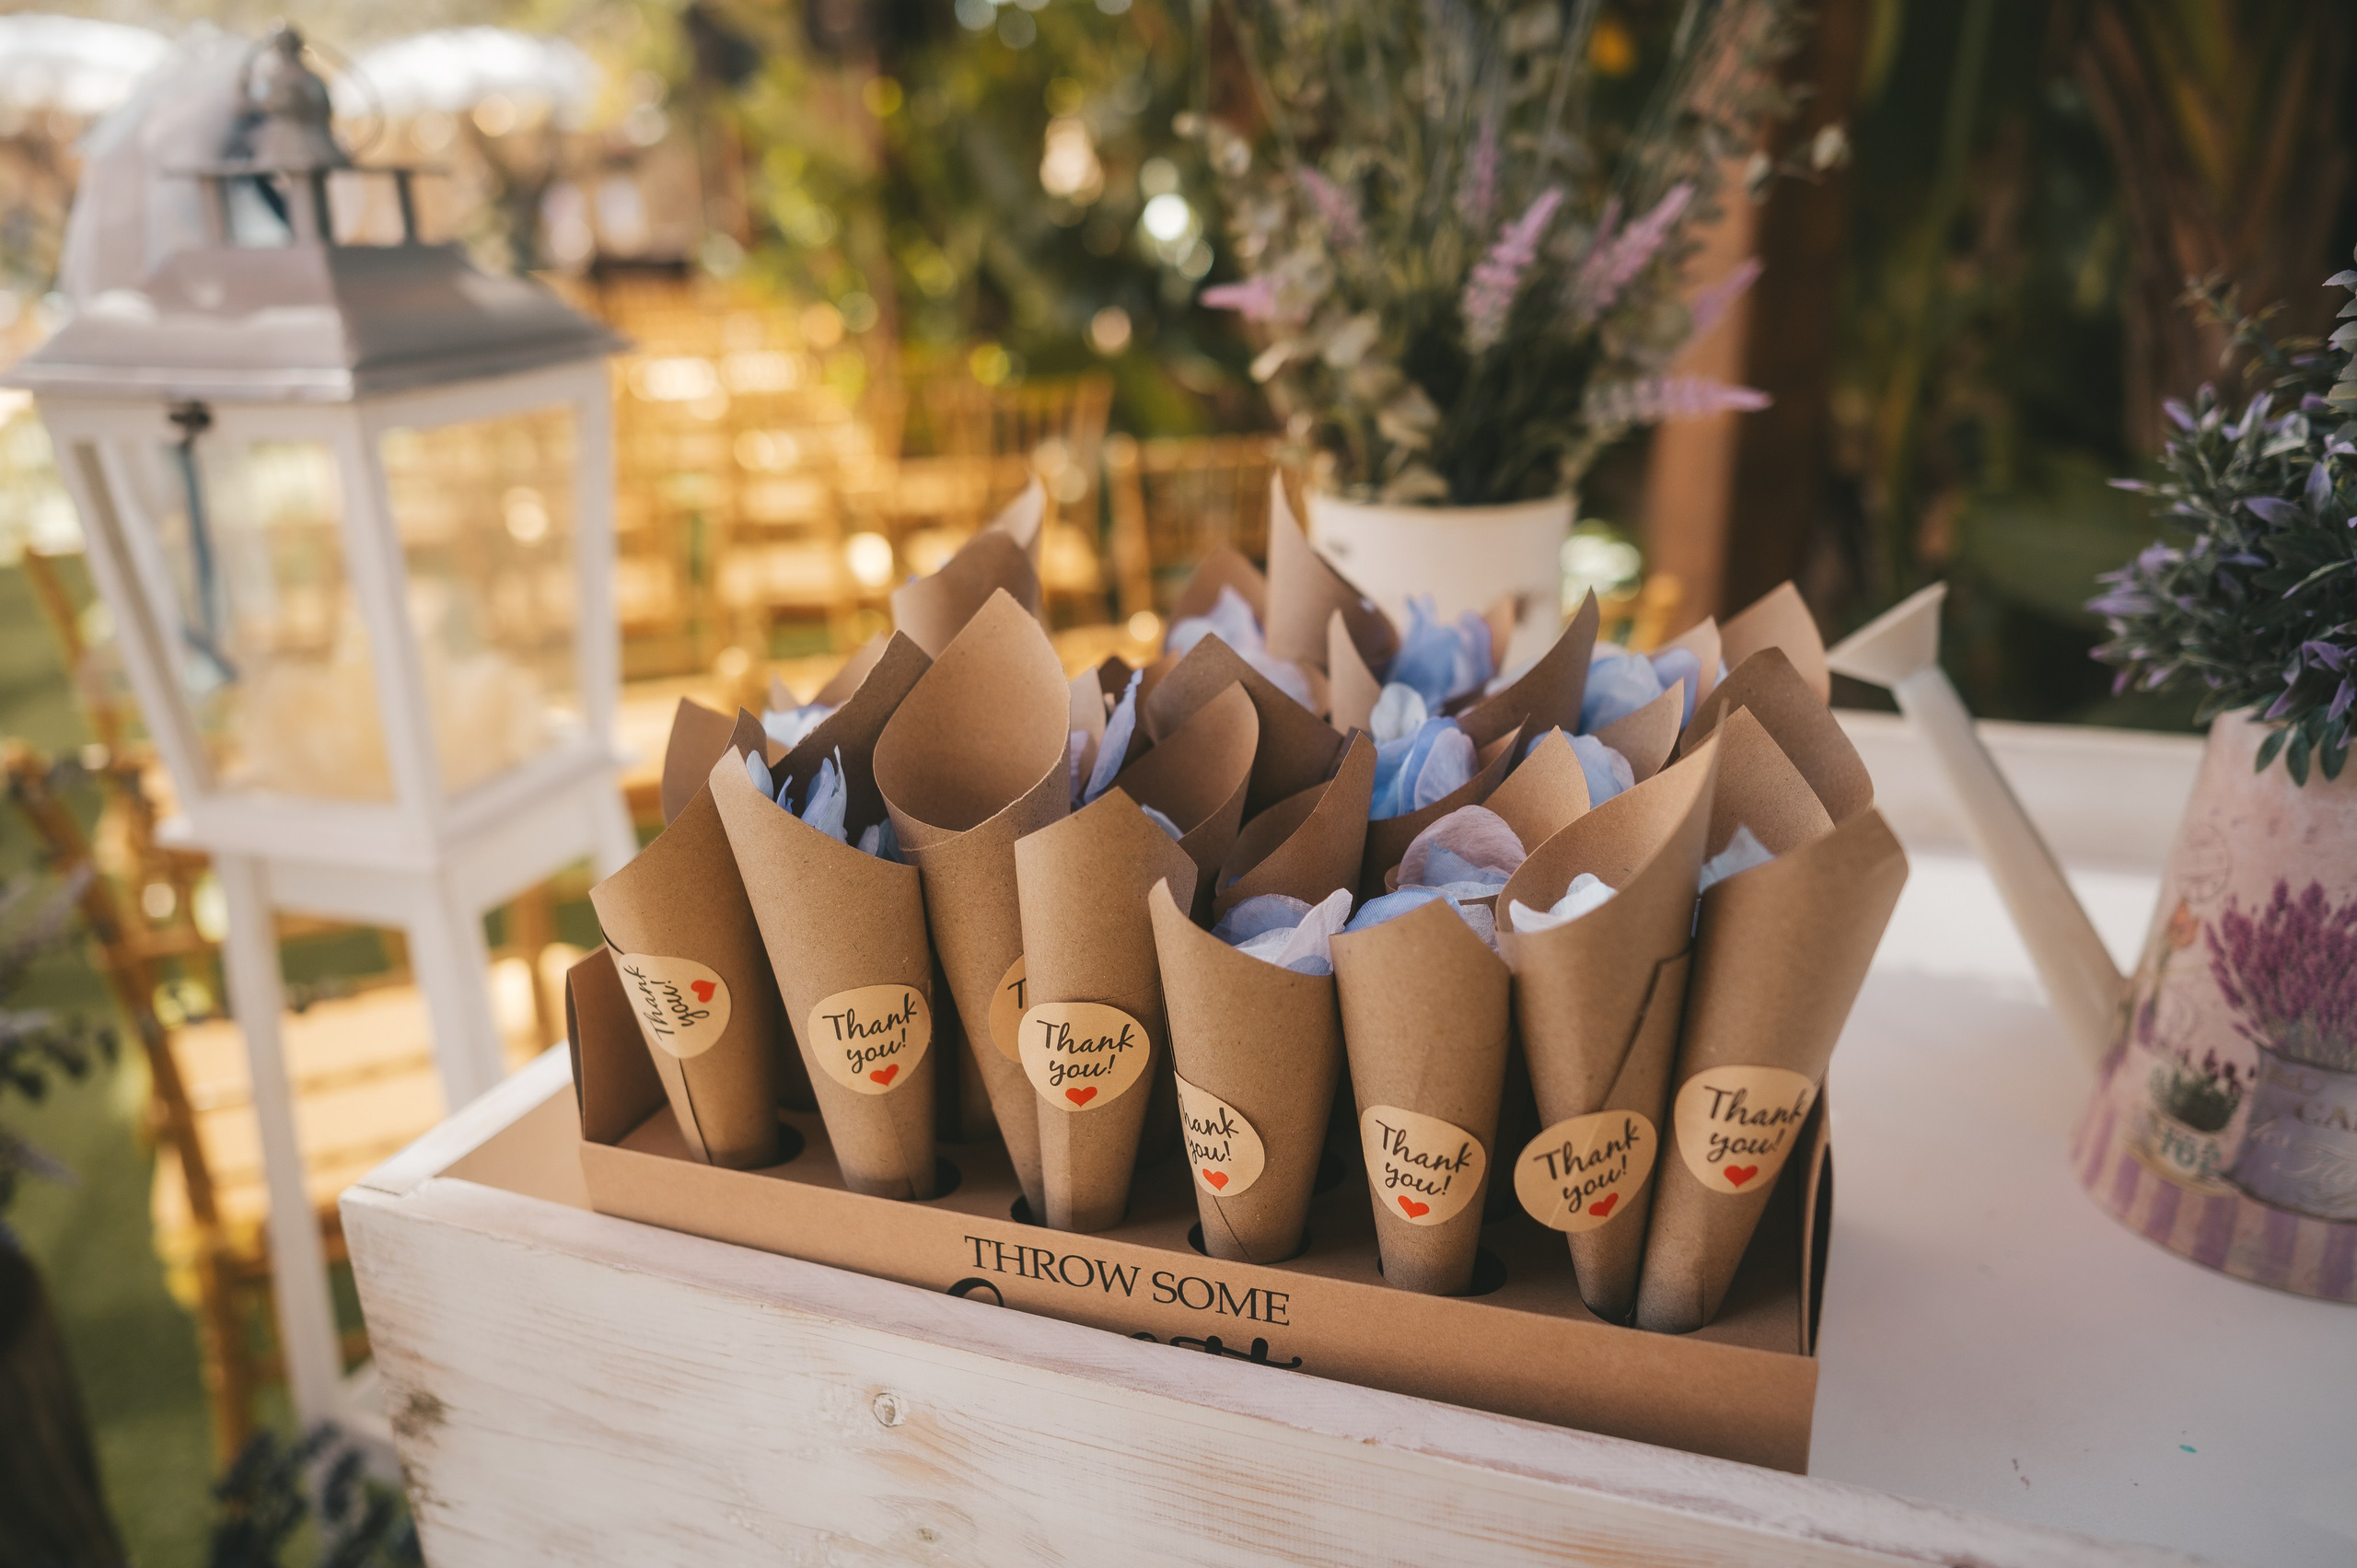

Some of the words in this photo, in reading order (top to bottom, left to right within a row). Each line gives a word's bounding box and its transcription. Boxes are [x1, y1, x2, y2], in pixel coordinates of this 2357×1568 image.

[623, 965, 675, 1041] Thank
[650, 981, 710, 1027] you!
[822, 993, 917, 1040] Thank
[846, 1028, 907, 1074] you!
[1037, 1019, 1135, 1054] Thank
[1049, 1054, 1116, 1086] you!
[1178, 1093, 1239, 1139] hank
[1703, 1086, 1807, 1125] Thank
[1188, 1135, 1232, 1164] you!
[1376, 1119, 1472, 1173] Thank
[1533, 1117, 1640, 1180] Thank
[1706, 1128, 1786, 1163] you!
[1385, 1161, 1452, 1196] you!
[1562, 1154, 1627, 1214] you!
[964, 1235, 1142, 1297] THROW
[1152, 1270, 1291, 1326] SOME
